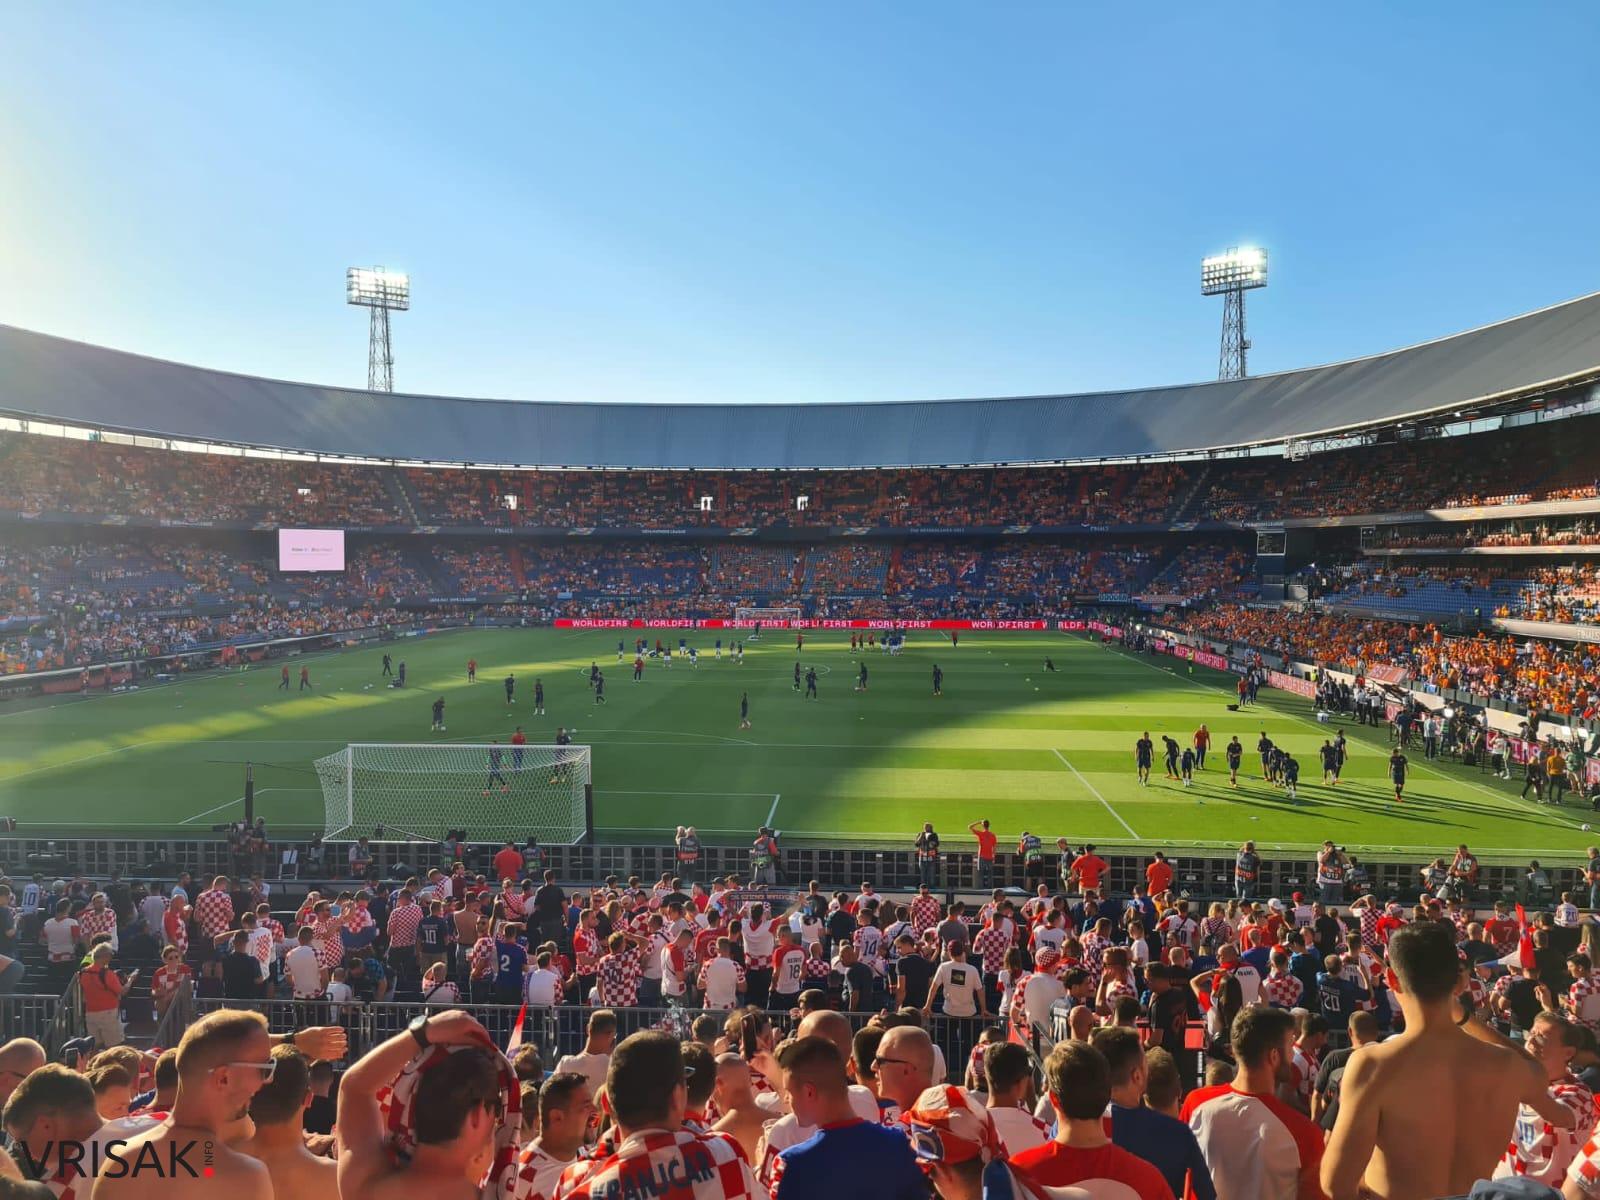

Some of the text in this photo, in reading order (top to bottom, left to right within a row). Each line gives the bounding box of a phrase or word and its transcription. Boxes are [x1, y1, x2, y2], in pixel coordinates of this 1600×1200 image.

[572, 619, 629, 628] WORLDFIRS
[24, 892, 36, 906] 10
[424, 929, 437, 945] 10
[1503, 926, 1513, 943] 7
[500, 954, 511, 972] 2
[789, 964, 801, 979] 18
